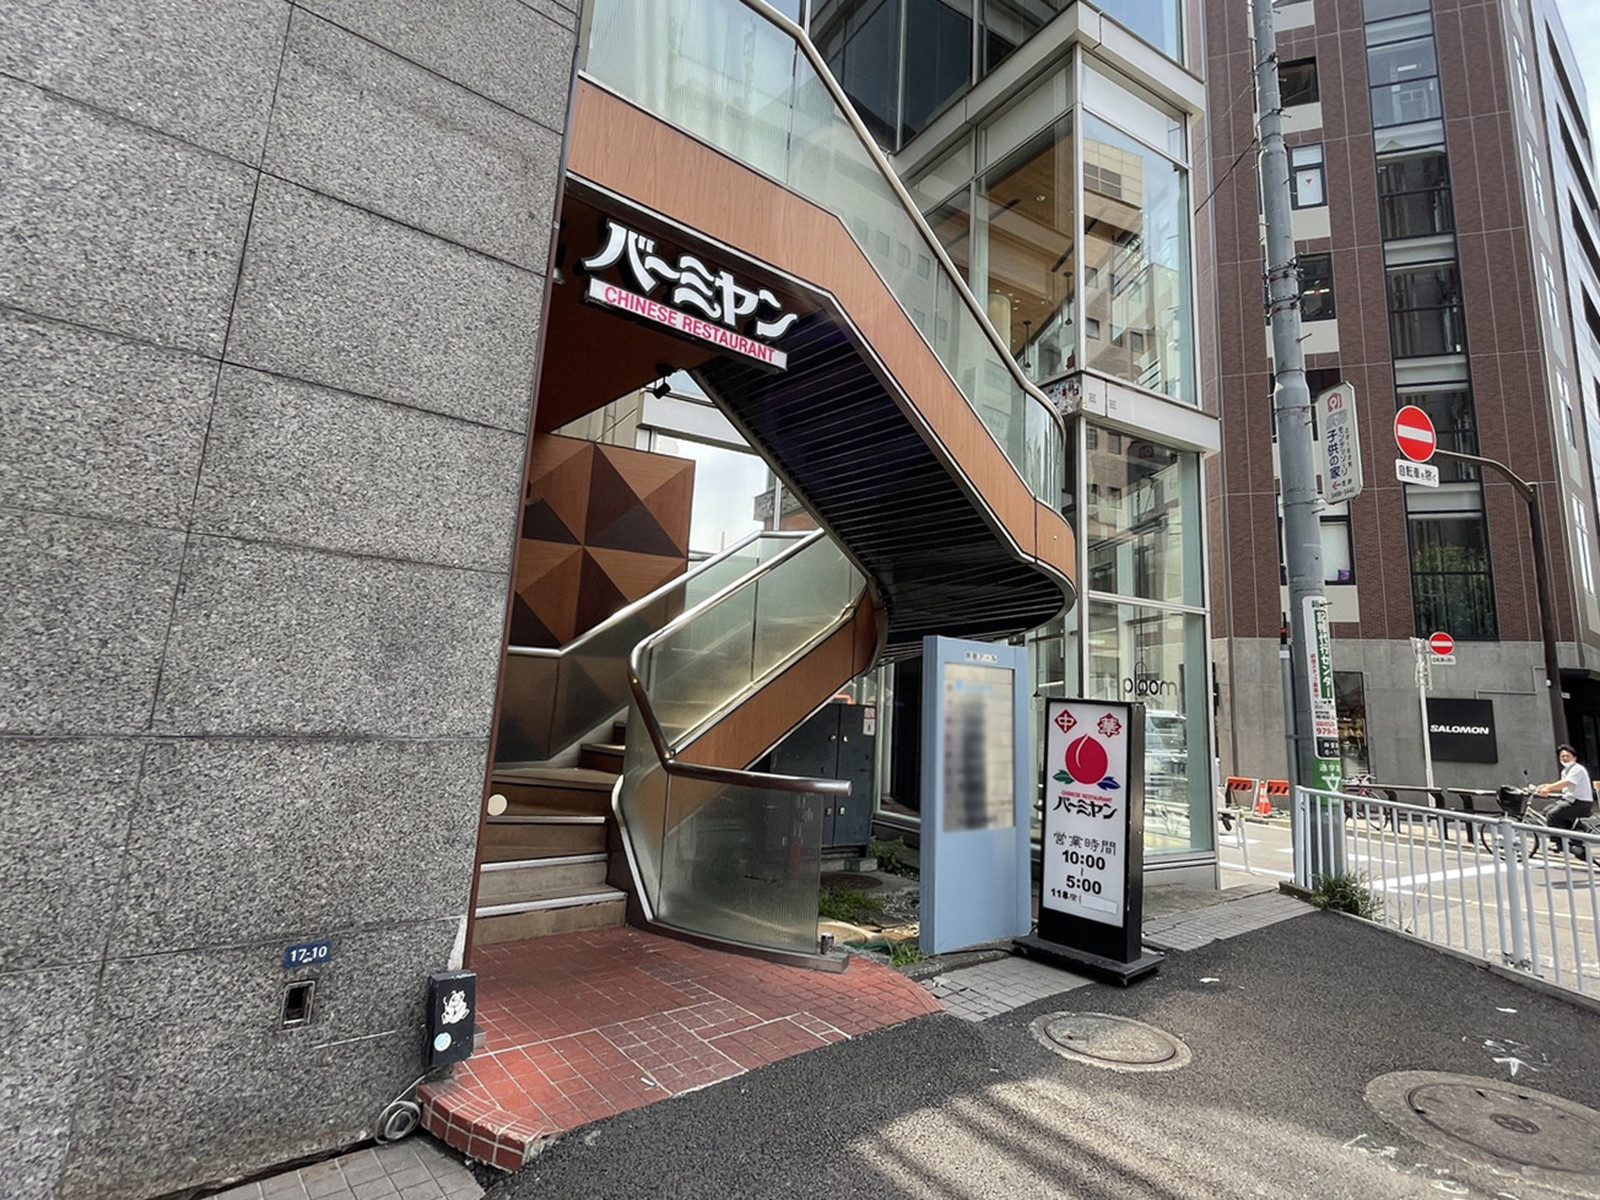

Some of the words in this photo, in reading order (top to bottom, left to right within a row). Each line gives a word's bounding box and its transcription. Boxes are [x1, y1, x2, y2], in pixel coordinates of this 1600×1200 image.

[584, 221, 798, 337] バーミヤン
[604, 286, 678, 327] CHINESE
[682, 315, 775, 362] RESTAURANT
[1430, 725, 1489, 735] SALOMON
[1053, 796, 1118, 819] バーミヤン
[1053, 832, 1116, 856] 営業時間
[1062, 850, 1106, 870] 10:00
[1066, 875, 1102, 895] 5:00
